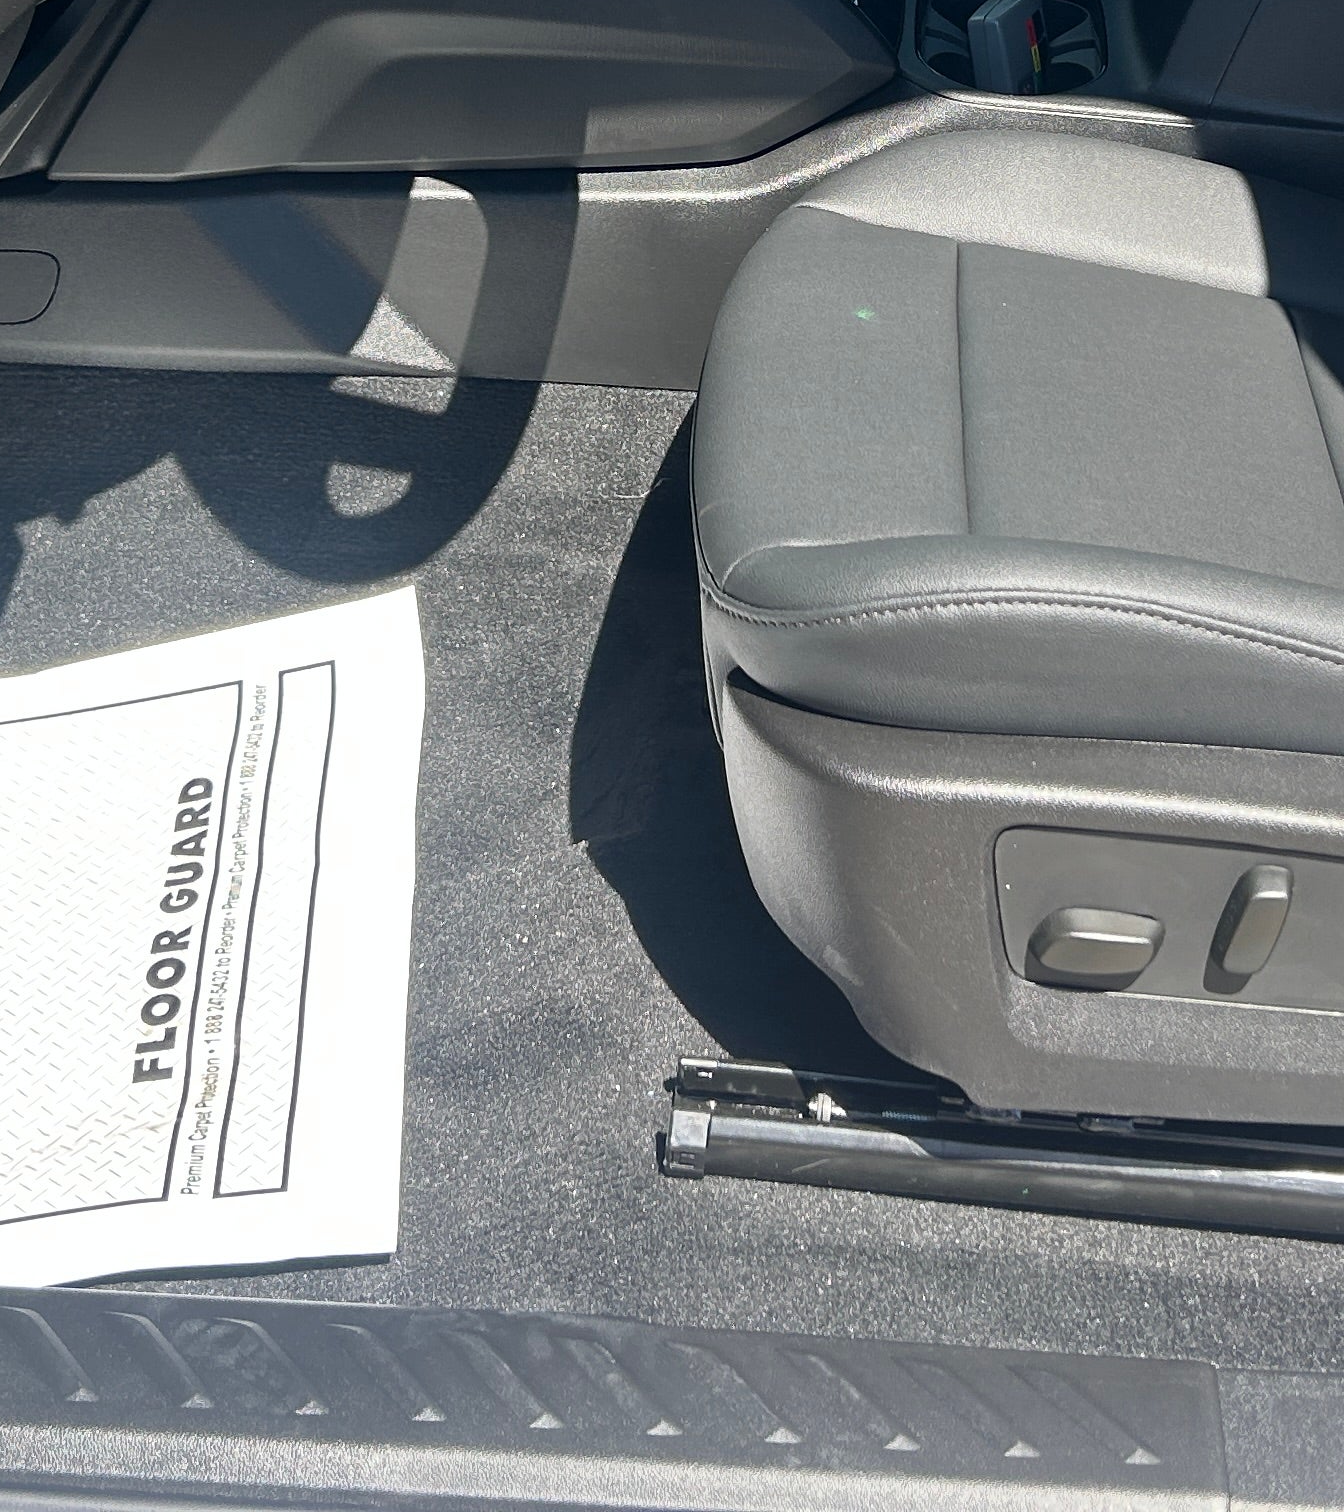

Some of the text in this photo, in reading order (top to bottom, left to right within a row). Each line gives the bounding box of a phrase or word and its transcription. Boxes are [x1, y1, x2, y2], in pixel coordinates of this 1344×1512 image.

[249, 684, 268, 721] Reorder
[232, 792, 253, 838] Protection
[228, 839, 249, 873] Carpet
[222, 875, 242, 909] Premium
[132, 775, 214, 1085] FLOOR GUARD
[215, 917, 237, 955] Reorder
[215, 957, 231, 968] to
[205, 1014, 223, 1034] 888
[195, 1057, 221, 1108] Protection
[188, 1111, 213, 1142] Carpet
[181, 1144, 205, 1195] Premium
